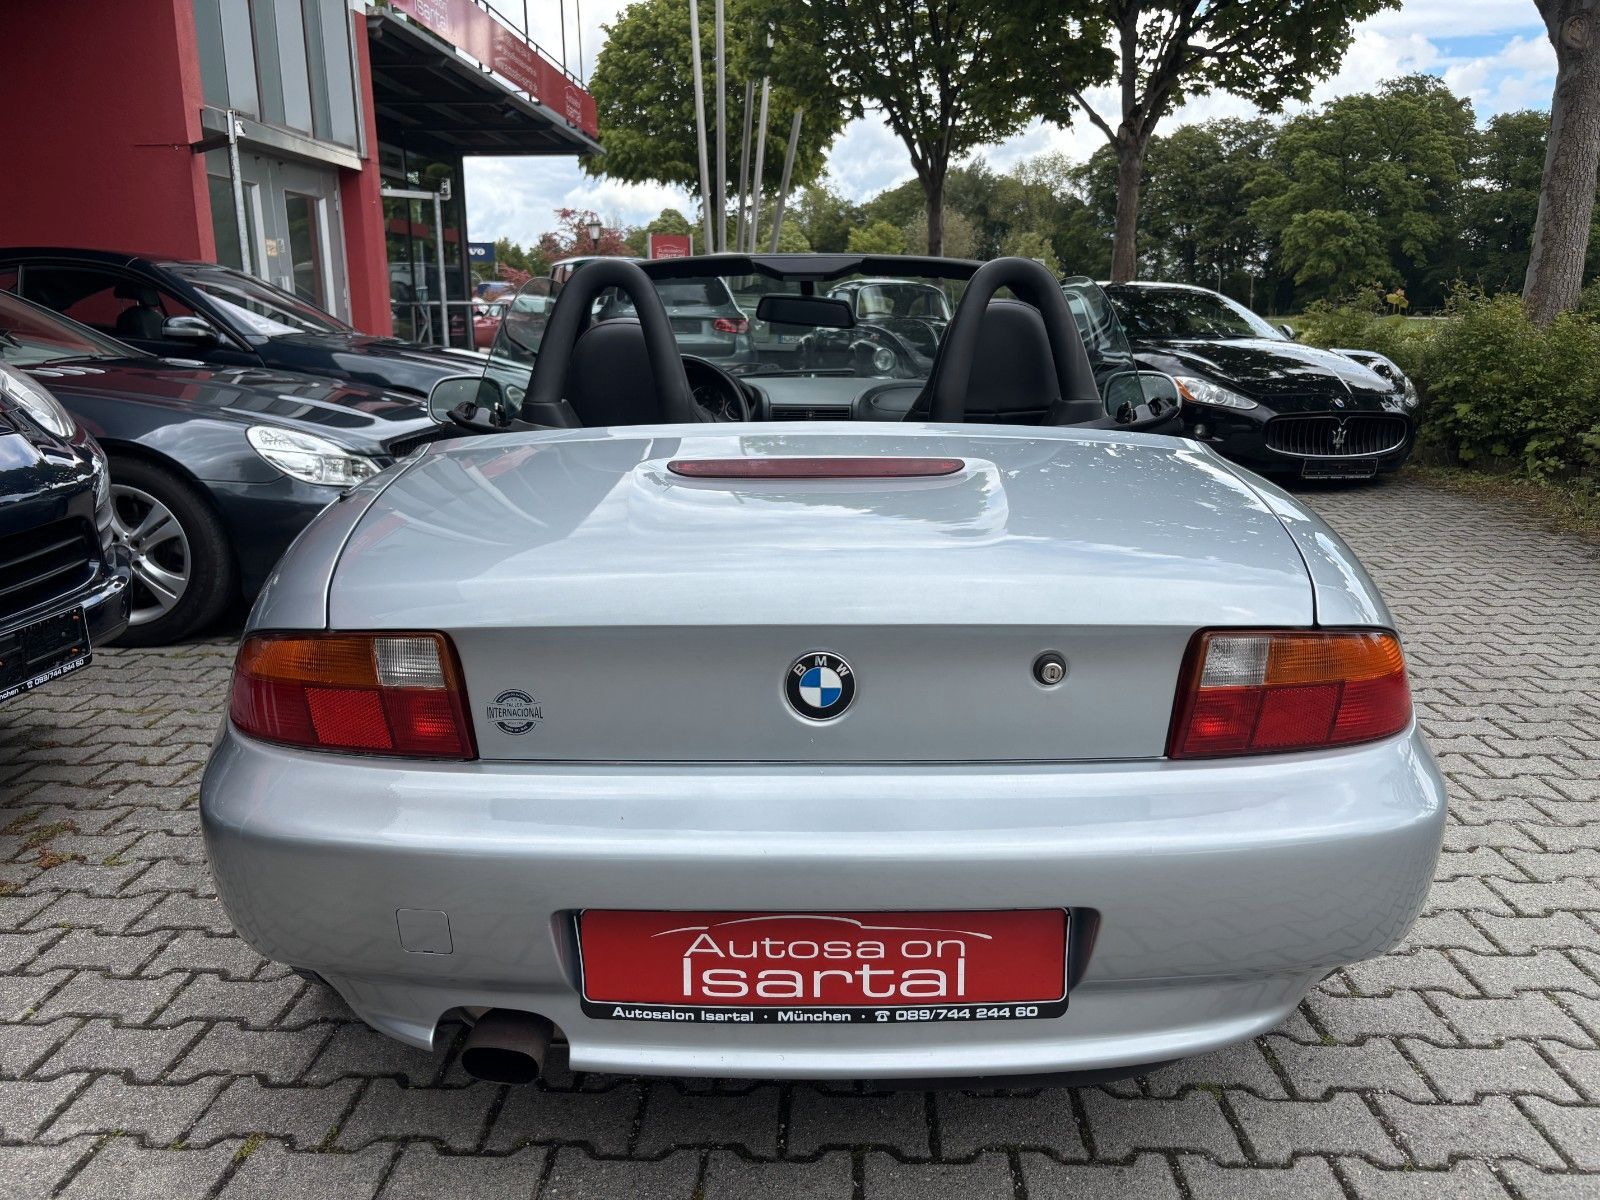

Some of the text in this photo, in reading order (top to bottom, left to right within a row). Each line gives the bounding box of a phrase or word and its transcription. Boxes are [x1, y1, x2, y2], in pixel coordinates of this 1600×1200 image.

[793, 655, 850, 677] BMW
[486, 706, 544, 720] INTERNACIONAL
[682, 957, 967, 998] Isartal
[612, 1006, 1039, 1022] Autosalon Isartal München 089/744 244 60
